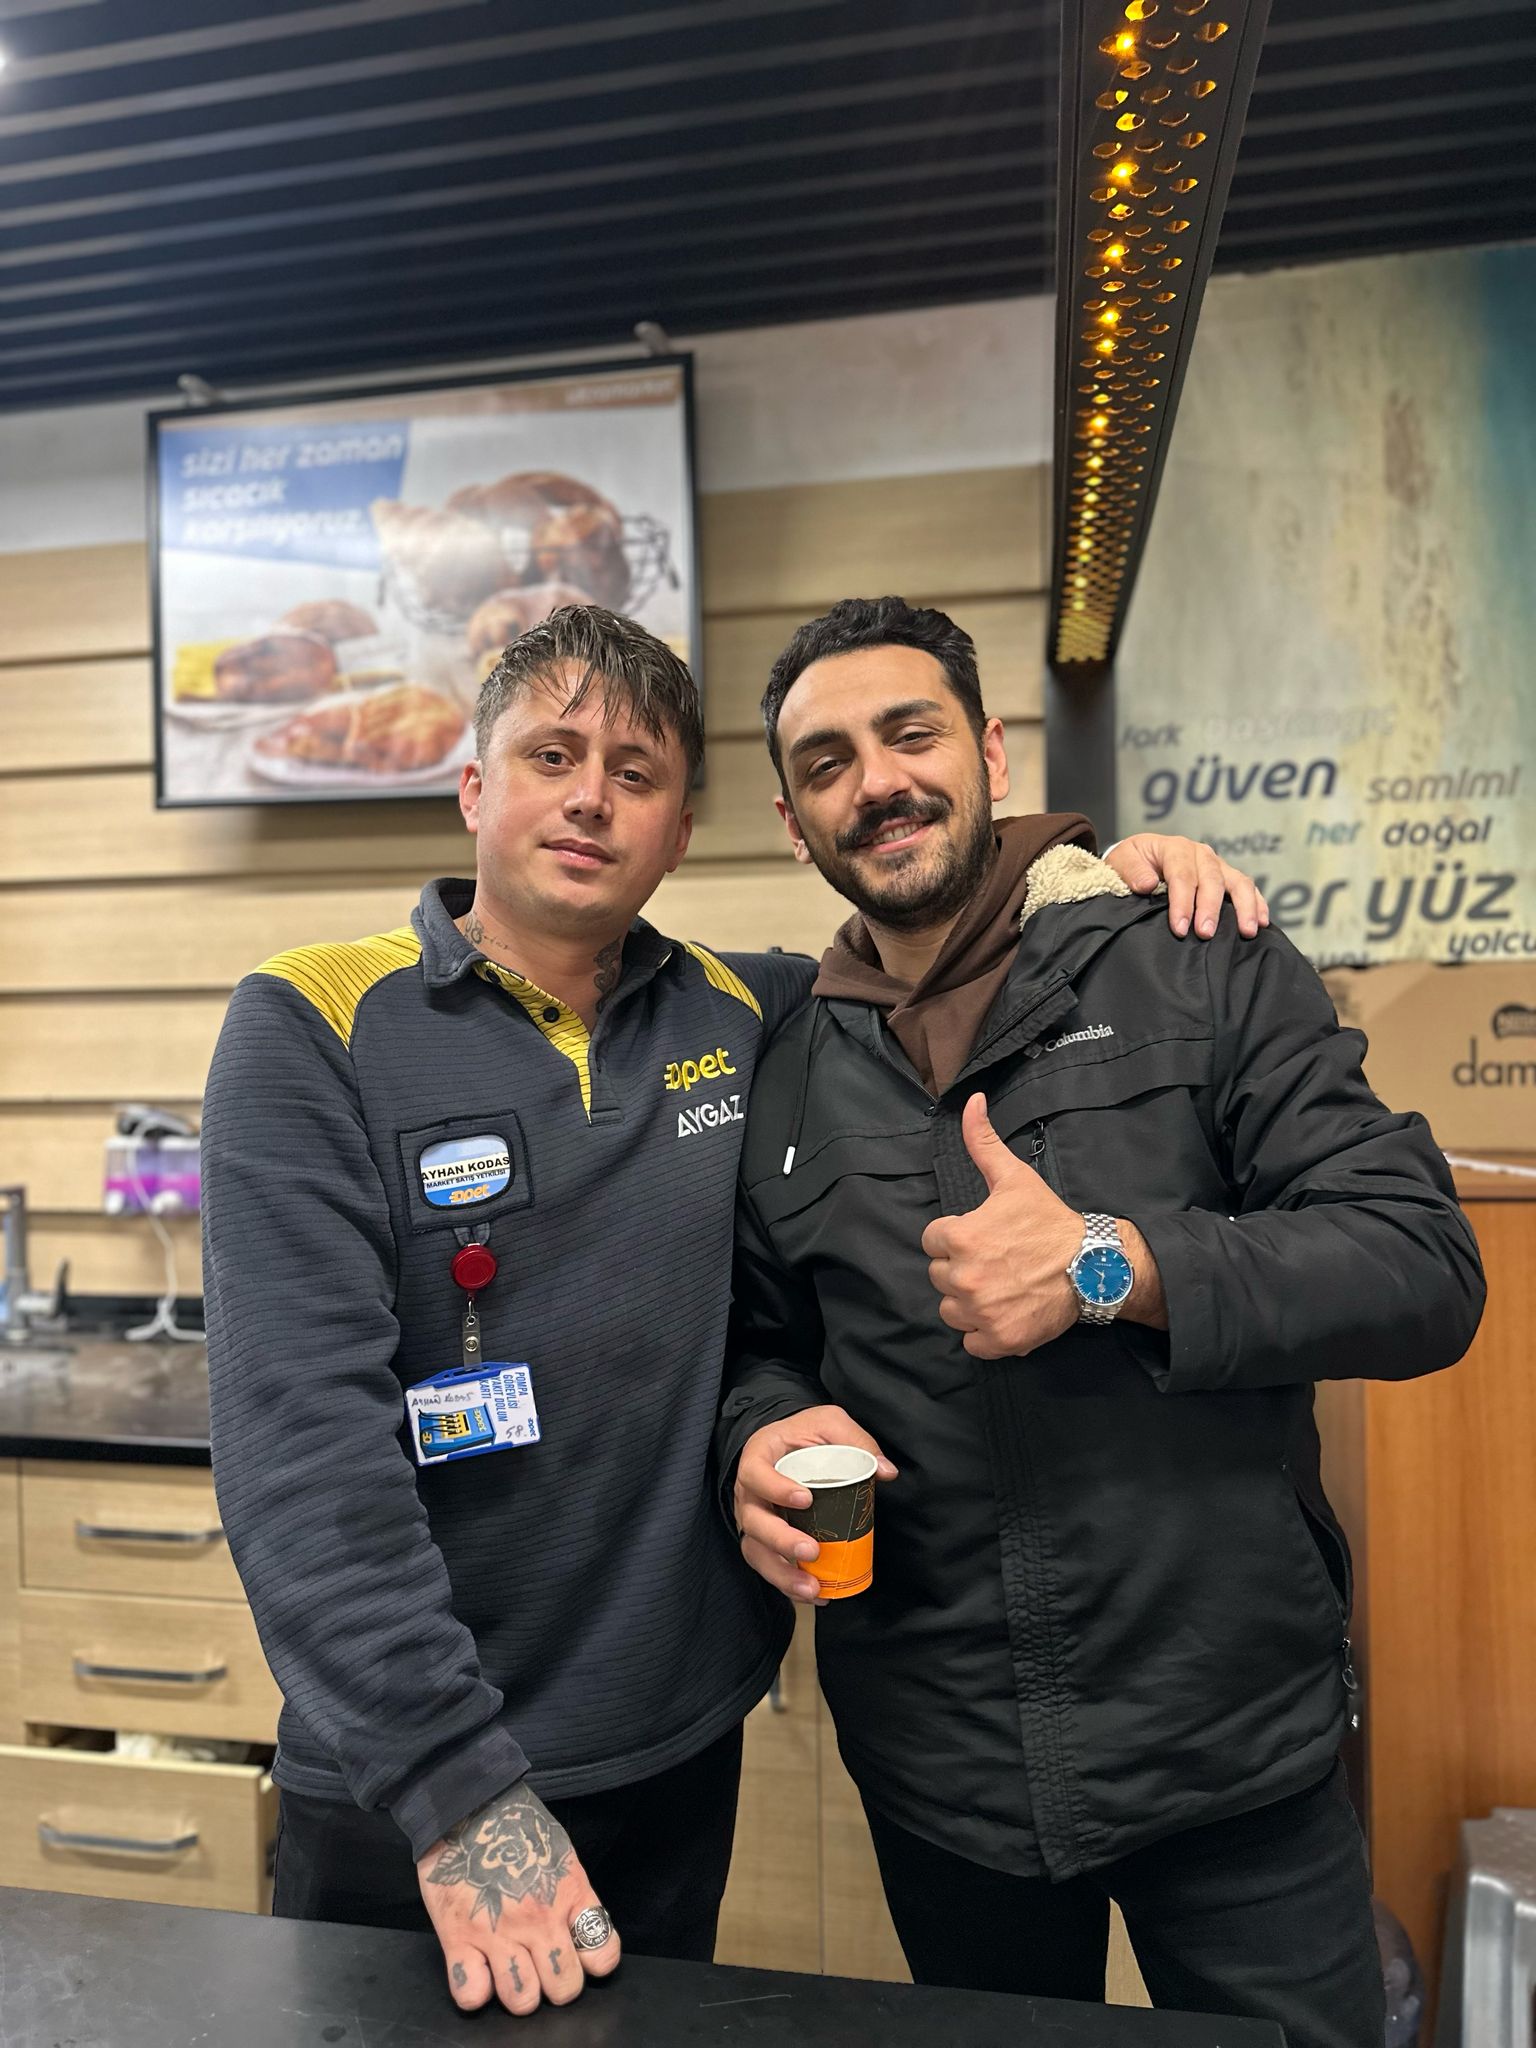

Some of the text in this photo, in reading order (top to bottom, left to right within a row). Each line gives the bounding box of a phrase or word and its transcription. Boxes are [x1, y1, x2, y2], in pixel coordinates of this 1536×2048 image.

[1141, 753, 1338, 823] güven
[1306, 820, 1362, 847] her
[1382, 816, 1494, 854] doğal
[1364, 860, 1518, 943] yüz
[1044, 1023, 1115, 1052] Columbia
[663, 1047, 737, 1092] opet
[677, 1094, 745, 1138] AYGAZ
[421, 1165, 464, 1181] AYHAN
[426, 1179, 454, 1189] MARKET
[449, 1184, 490, 1202] opet
[479, 1379, 492, 1399] KARTI
[491, 1376, 509, 1422] YAKIT DOLUM
[515, 1372, 529, 1396] POMPA
